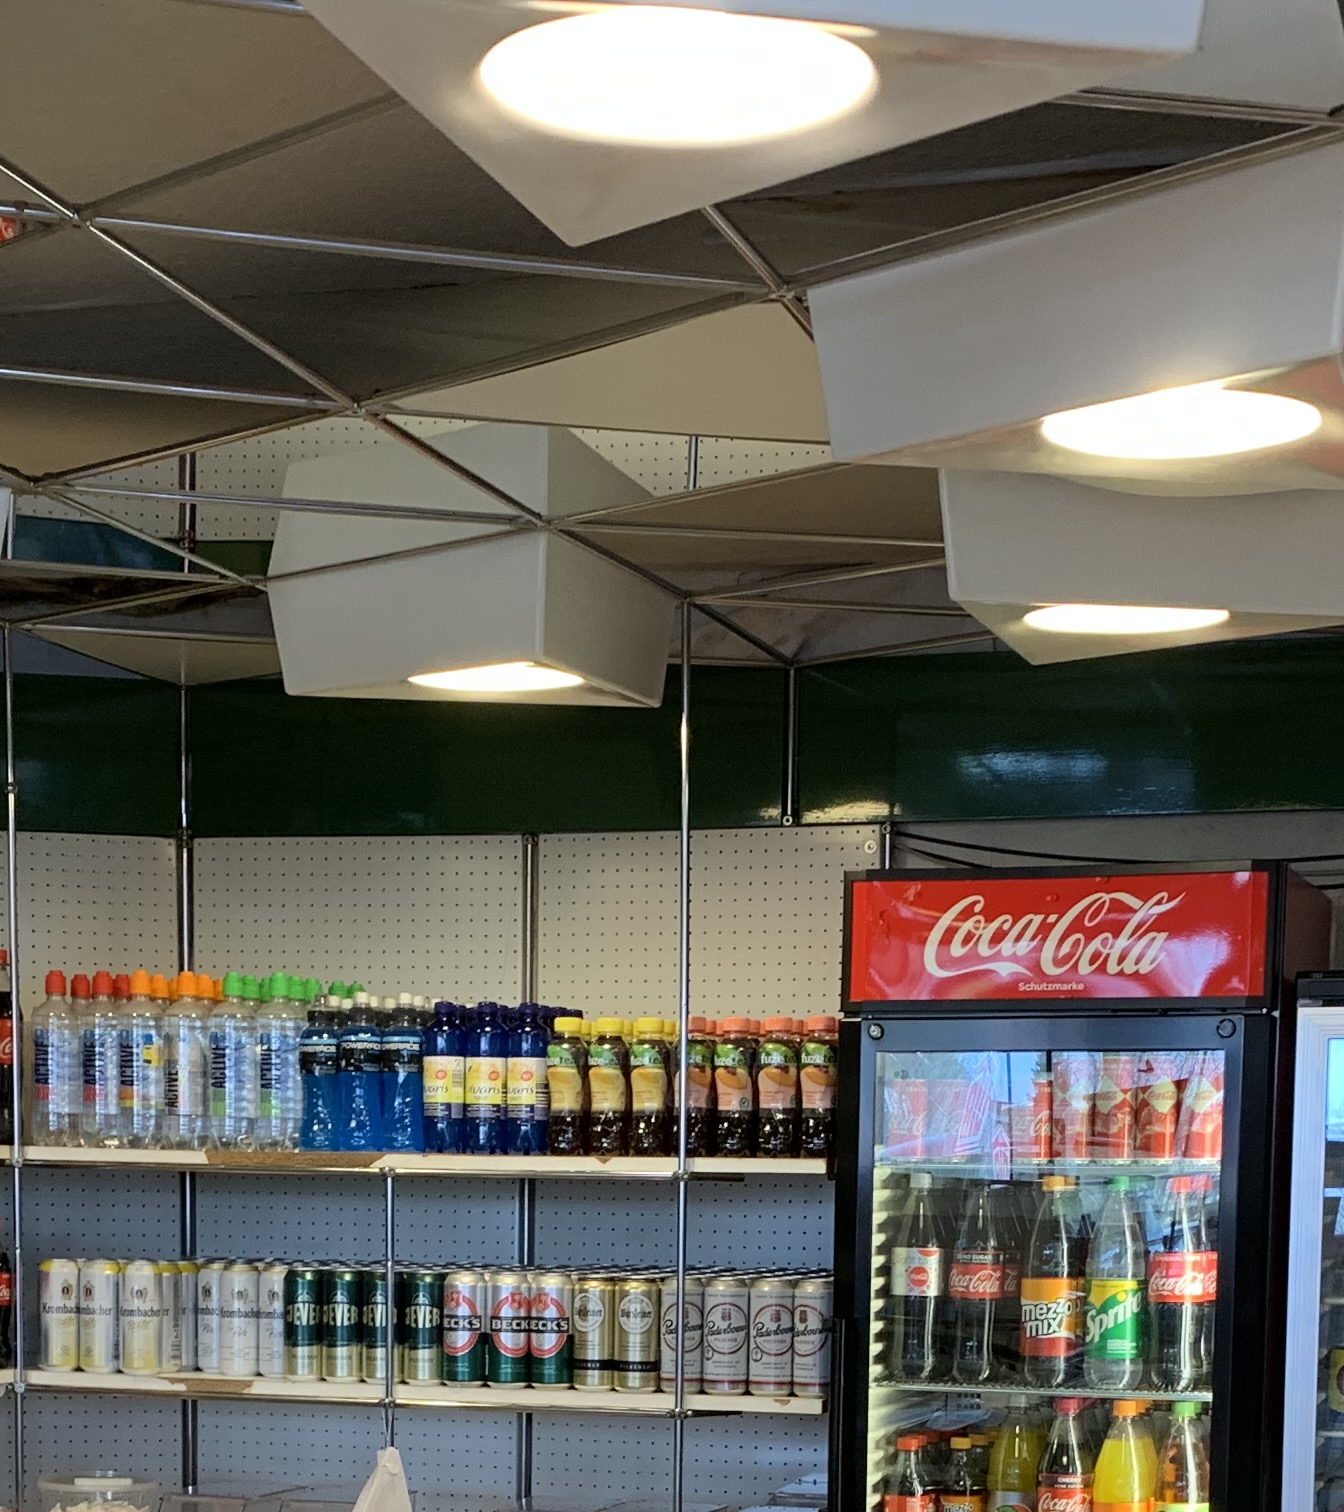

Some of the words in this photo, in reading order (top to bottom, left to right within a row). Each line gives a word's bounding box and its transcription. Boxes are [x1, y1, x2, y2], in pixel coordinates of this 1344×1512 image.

[923, 889, 1187, 978] Coca-Cola
[1018, 981, 1086, 993] Schutzmarke
[1085, 1290, 1143, 1343] Sprite
